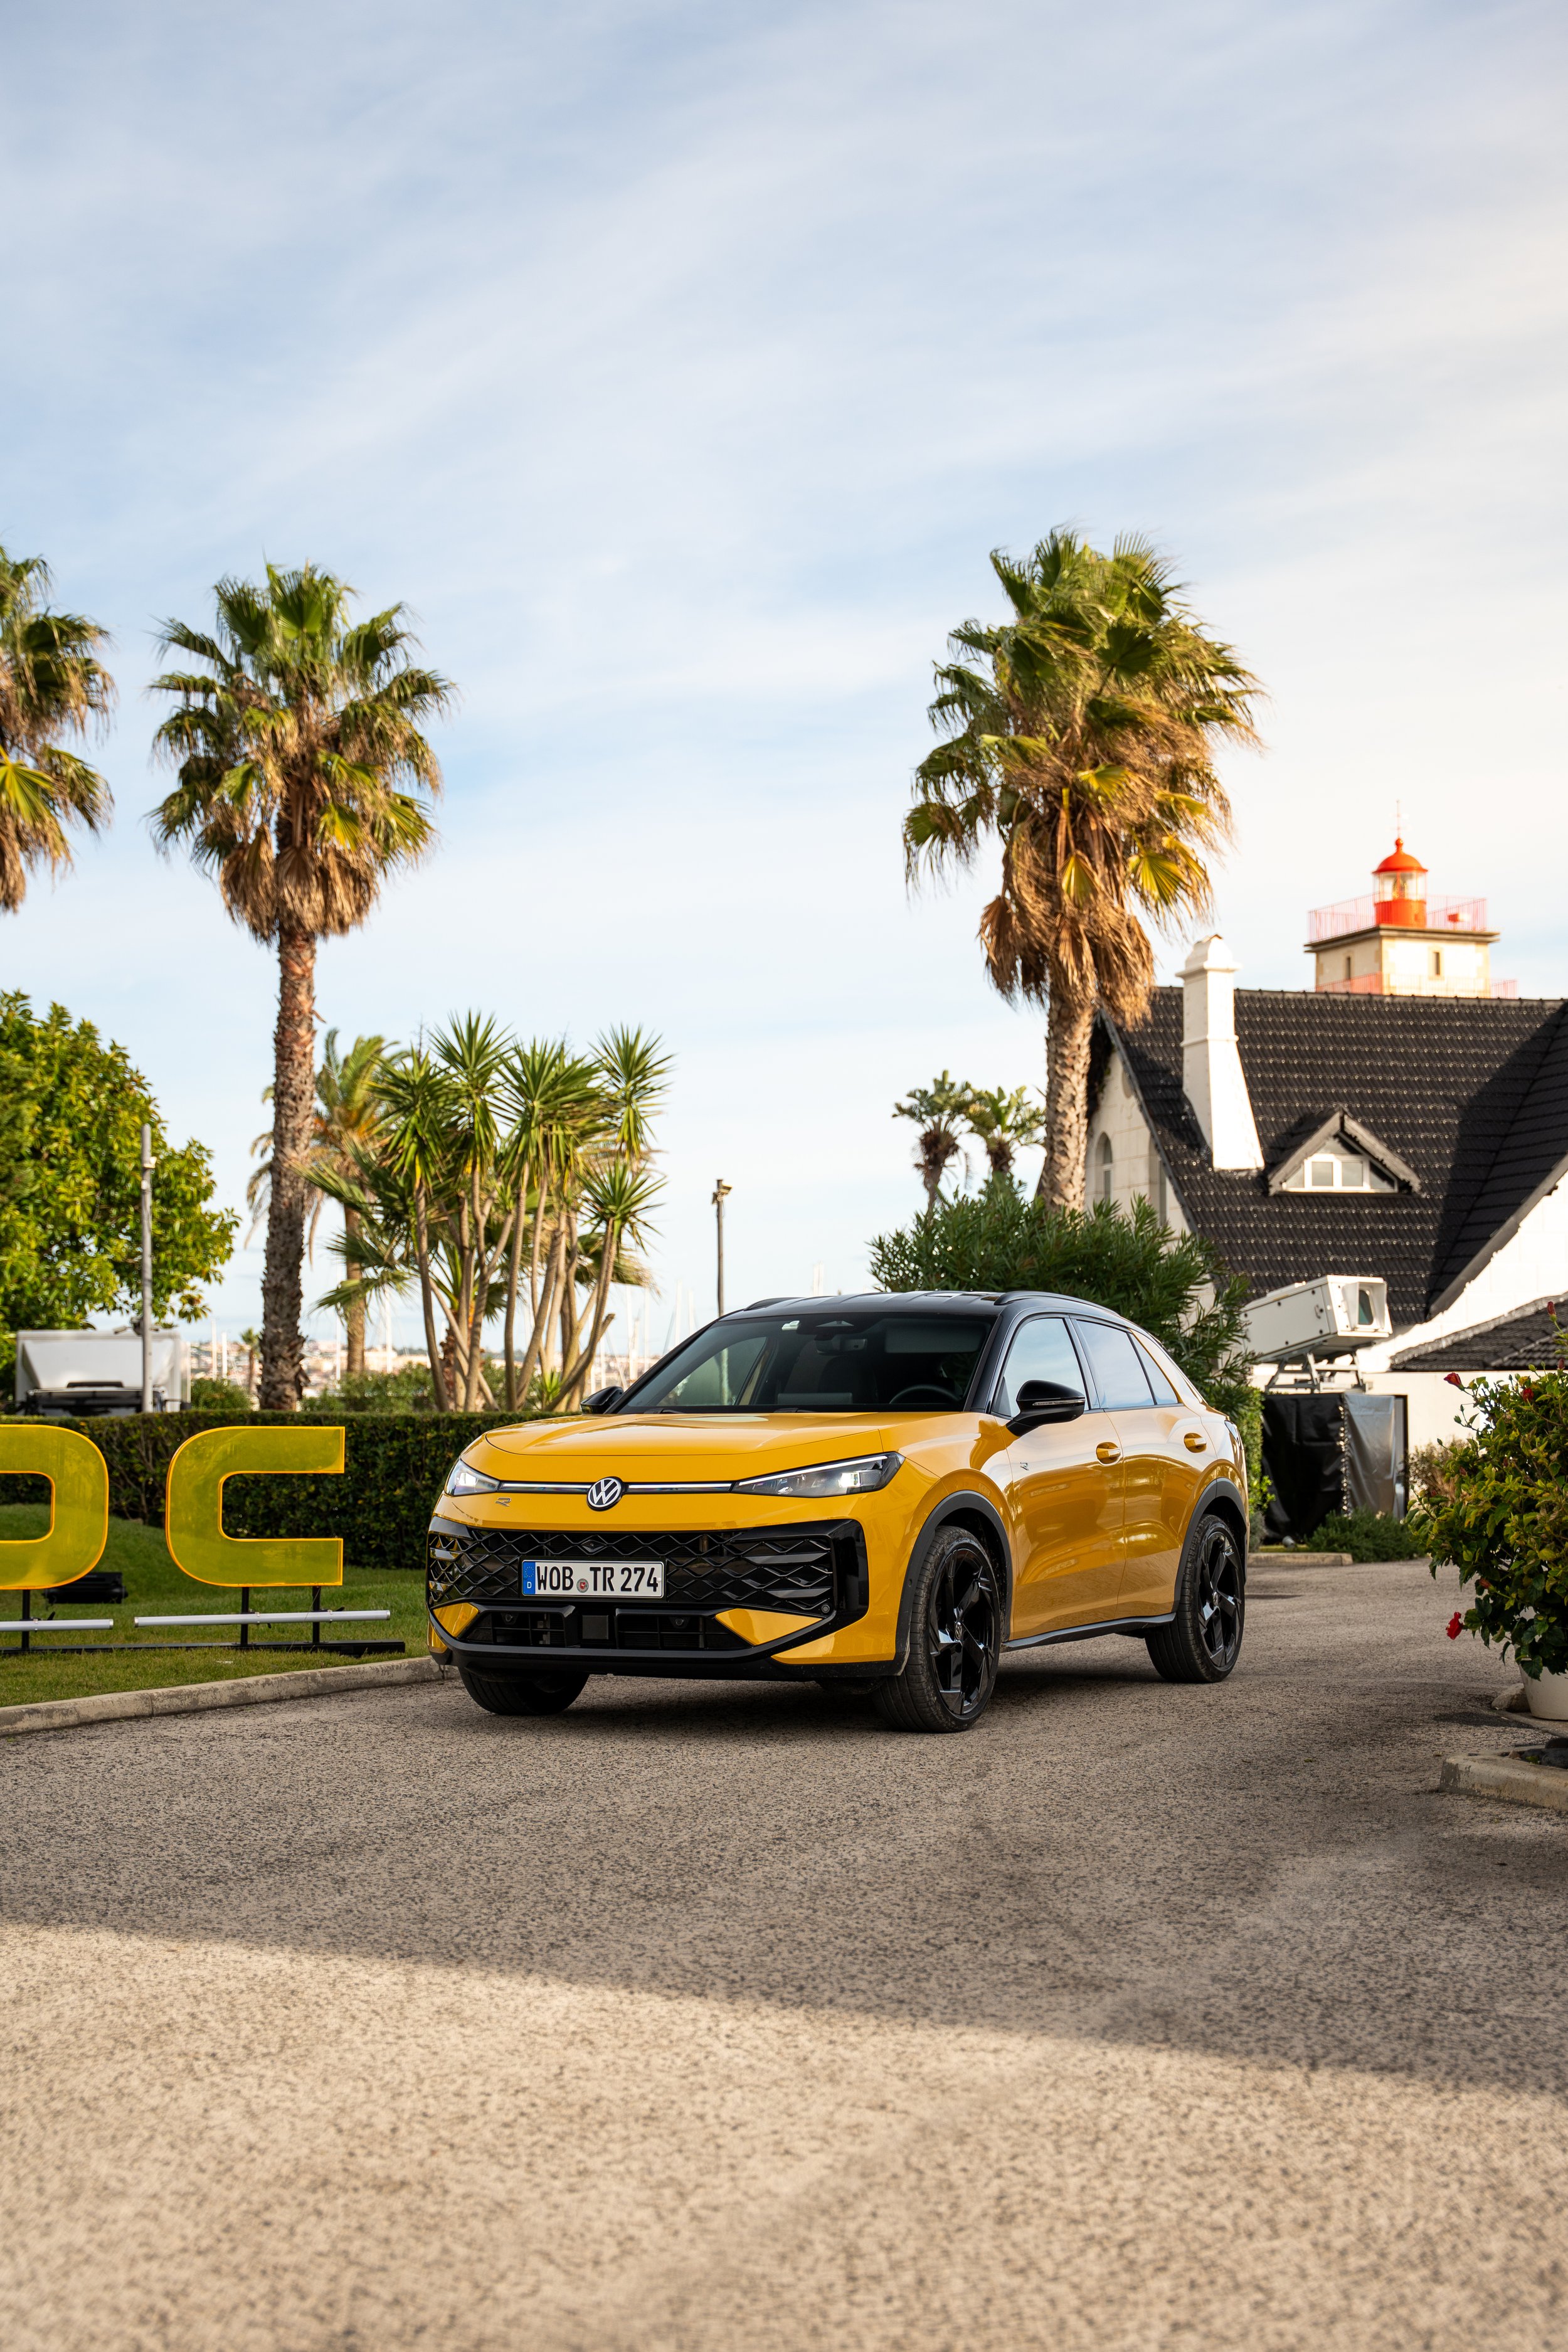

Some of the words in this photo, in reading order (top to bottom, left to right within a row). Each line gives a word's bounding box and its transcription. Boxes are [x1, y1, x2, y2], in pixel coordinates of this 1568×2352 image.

[589, 1477, 621, 1507] VW
[536, 1565, 574, 1591] WOB
[589, 1566, 615, 1592] TR
[620, 1567, 659, 1592] 274
